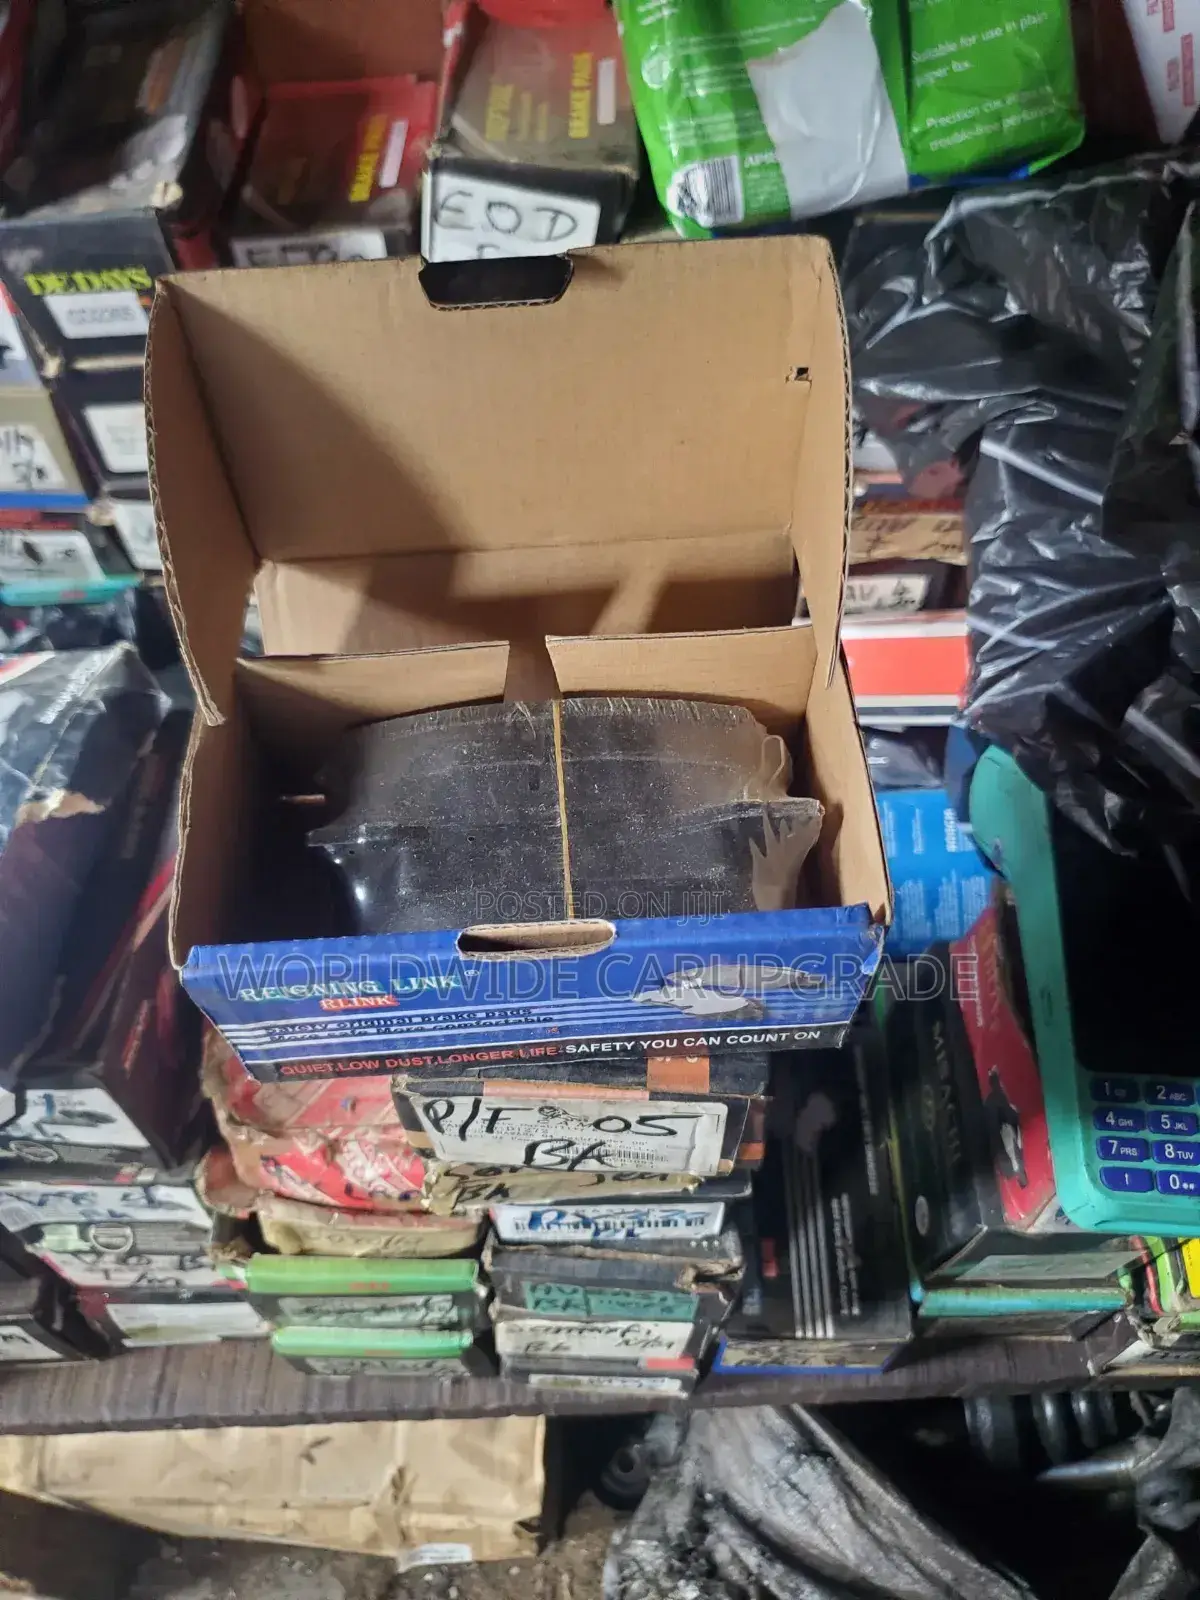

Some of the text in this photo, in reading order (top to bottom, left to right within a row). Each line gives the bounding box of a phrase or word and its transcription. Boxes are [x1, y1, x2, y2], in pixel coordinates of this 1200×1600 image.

[240, 975, 461, 1002] REIGNING LINK
[320, 995, 395, 1010] RLINK
[421, 1010, 478, 1024] brake
[432, 1014, 554, 1032] comfortable
[565, 1041, 636, 1054] SAFETY
[640, 1037, 678, 1050] YOU
[683, 1034, 722, 1047] CAN
[726, 1031, 791, 1044] COUNT
[794, 1030, 822, 1041] ON
[1155, 1084, 1167, 1100] 2
[1104, 1110, 1116, 1126] 4
[1160, 1113, 1189, 1131] 5 JKL
[1107, 1139, 1139, 1157] 7 PRS
[1163, 1142, 1195, 1161] 8 TUV
[1168, 1173, 1181, 1190] 0
